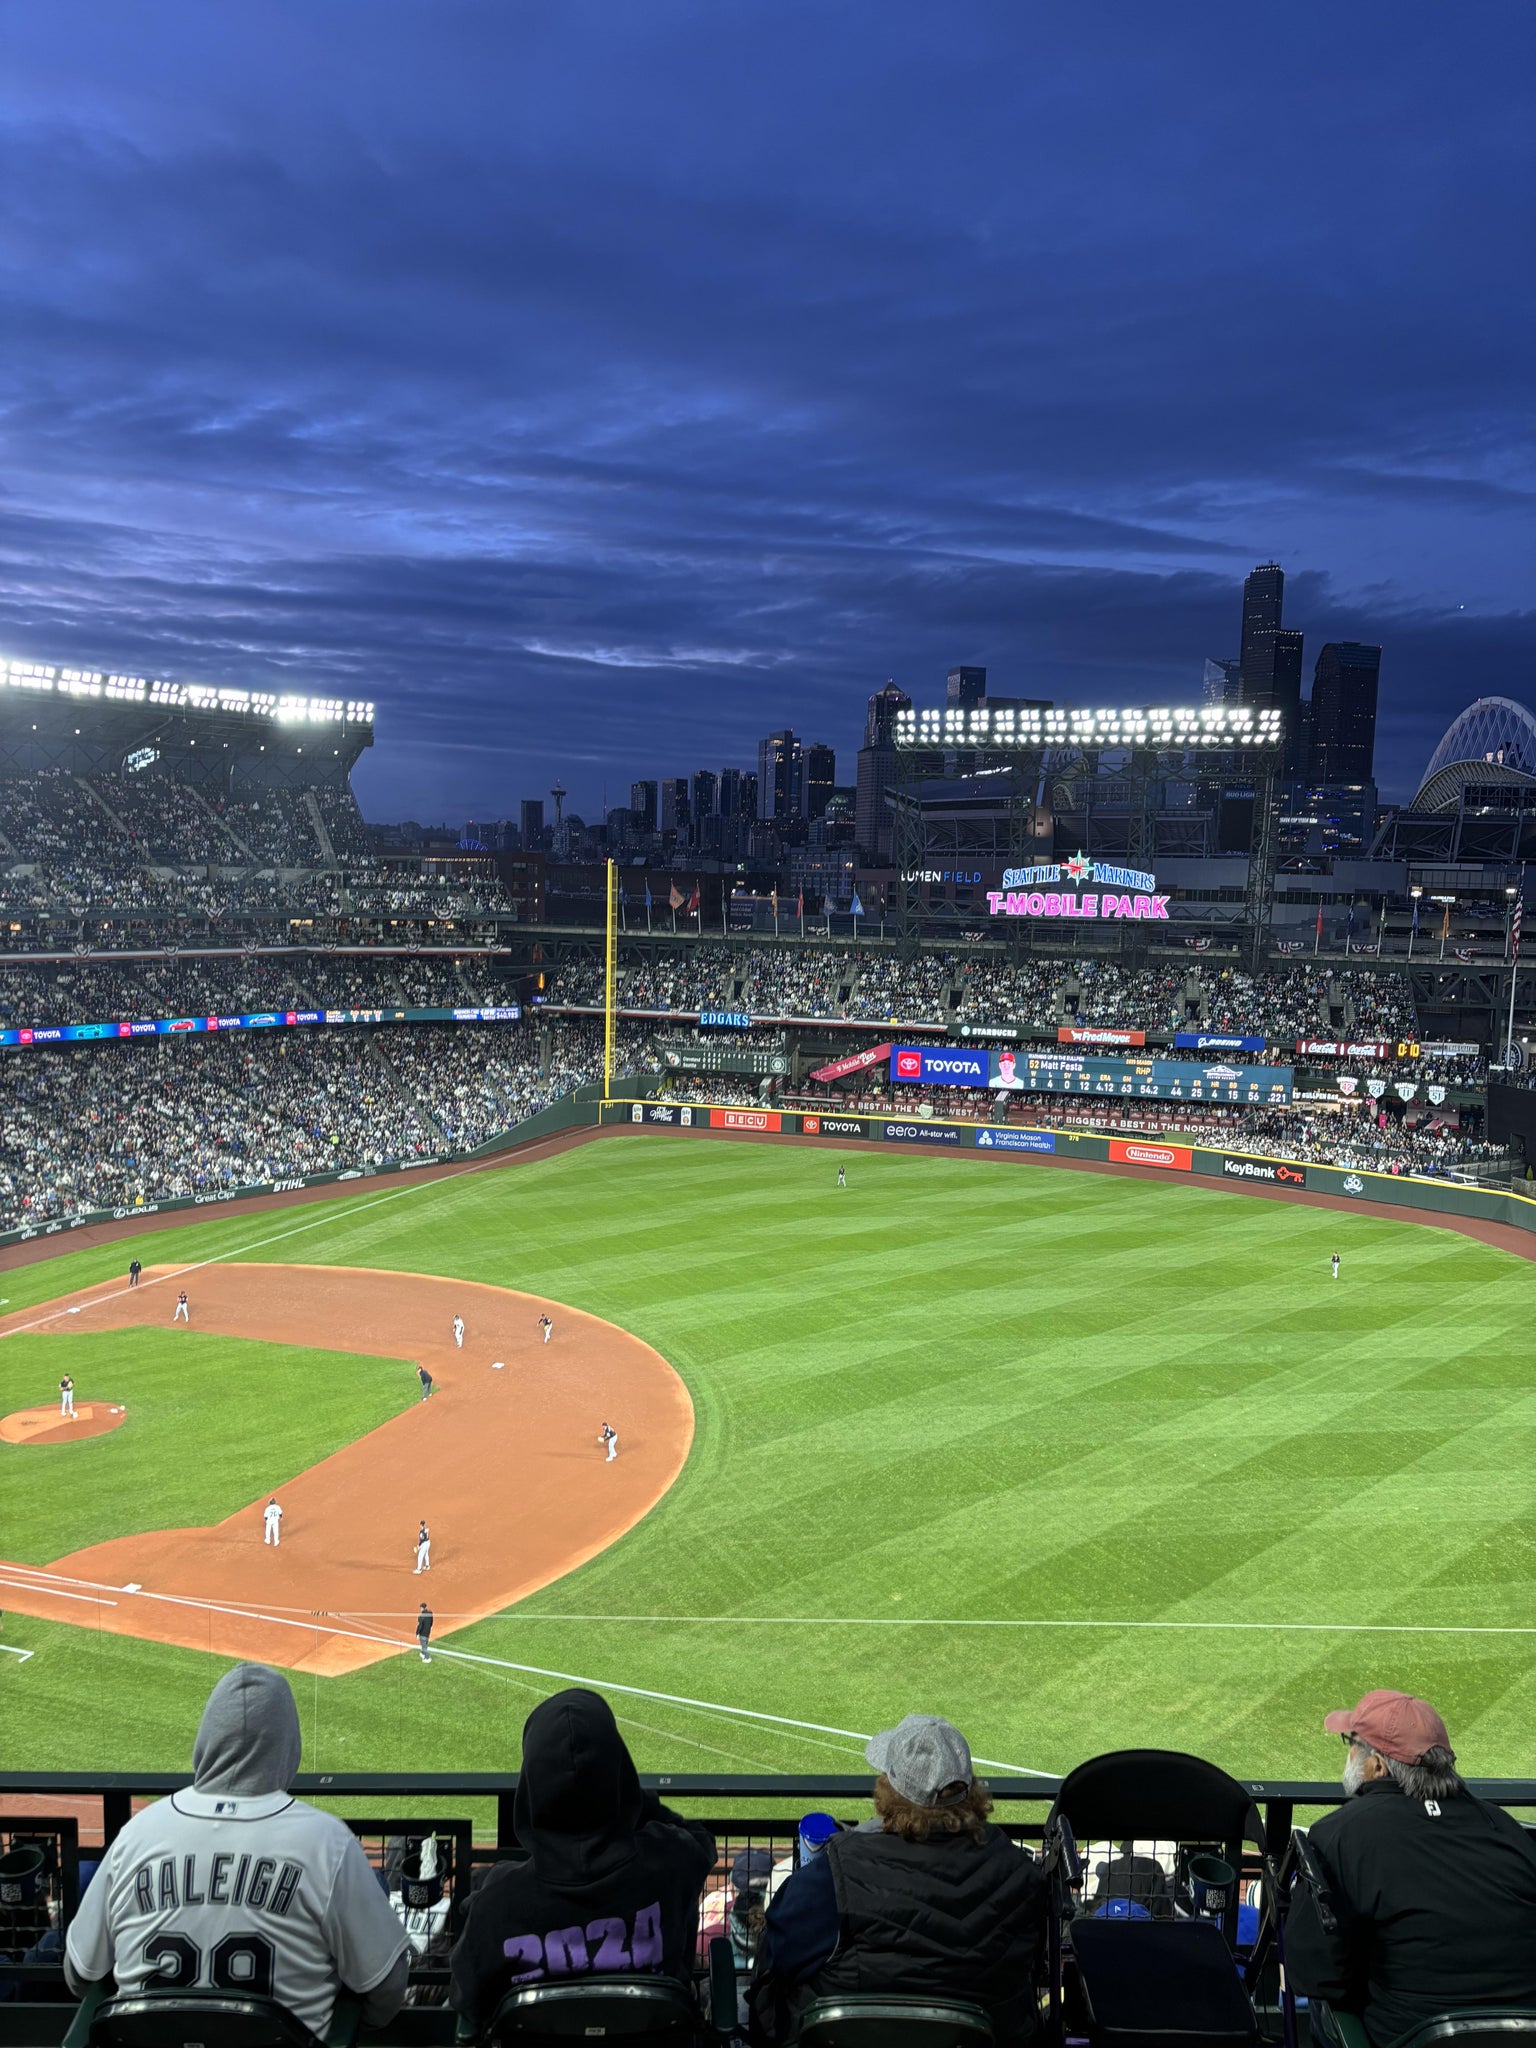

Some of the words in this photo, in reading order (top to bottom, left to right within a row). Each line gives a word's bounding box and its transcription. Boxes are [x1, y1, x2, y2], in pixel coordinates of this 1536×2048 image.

[901, 870, 941, 882] LUMEN
[944, 871, 982, 883] FIELD
[1003, 864, 1061, 889] SEATTLE
[1093, 863, 1156, 892] MARINERS
[987, 892, 1098, 917] T-MOBILE
[1102, 895, 1171, 919] PARK
[219, 1018, 240, 1027] TOYOTA
[297, 1014, 318, 1022] TOYOTA
[131, 1024, 155, 1032] TOYOTA
[972, 1028, 1018, 1037] STARBUCKS
[34, 1030, 61, 1040] TOYOTA
[1082, 1031, 1103, 1041] Fred
[1209, 1038, 1242, 1047] BOEING
[1308, 1042, 1337, 1054] Coca-Cola
[1347, 1044, 1377, 1056] Coca-Cola
[1398, 1043, 1419, 1058] 0:10
[925, 1059, 981, 1074] TOYOTA
[1040, 1060, 1059, 1070] Matt
[1060, 1061, 1083, 1071] Festa
[1136, 1067, 1151, 1075] RHP
[1030, 1078, 1036, 1087] 5
[1047, 1080, 1053, 1088] 4
[1064, 1080, 1070, 1089] 0
[1080, 1081, 1089, 1091] 12
[1096, 1082, 1114, 1092] 4.12
[1121, 1084, 1132, 1093] 63
[1140, 1085, 1159, 1095] 54.2
[1170, 1086, 1182, 1096] 44
[1191, 1088, 1202, 1097] 25
[1211, 1089, 1218, 1098] 4
[1228, 1090, 1238, 1100] 15
[1248, 1091, 1259, 1101] 56
[1267, 1093, 1286, 1103] .221
[1342, 1083, 1352, 1091] 42
[1371, 1086, 1381, 1094] 24
[1402, 1088, 1410, 1097] 11
[1302, 1092, 1326, 1100] BULLPEN
[1432, 1092, 1441, 1100] 51
[849, 1101, 856, 1109] &
[858, 1102, 880, 1110] BEST
[882, 1103, 892, 1111] IN
[895, 1104, 912, 1112] THE
[914, 1105, 972, 1116] NTHWEST
[728, 1114, 764, 1125] BECU
[1066, 1117, 1107, 1126] BIGGEST
[1110, 1119, 1117, 1127] &
[1120, 1120, 1145, 1129] BEST
[1148, 1122, 1158, 1130] IN
[1161, 1123, 1180, 1131] THE
[823, 1121, 861, 1133] TOYOTA
[886, 1125, 917, 1138] eero
[919, 1129, 943, 1138] All-star
[944, 1131, 958, 1139] wifi.
[995, 1132, 1019, 1141] Virginia
[995, 1140, 1029, 1148] Franciscan
[1130, 1149, 1171, 1161] Nintendo
[1224, 1160, 1275, 1179] KeyBank
[273, 1178, 306, 1192] STIHL
[1347, 1177, 1360, 1186] 50
[195, 1193, 217, 1204] Great
[217, 1190, 236, 1202] Clips
[125, 1204, 158, 1216] LEXUS
[134, 1853, 303, 1916] RALEIGH
